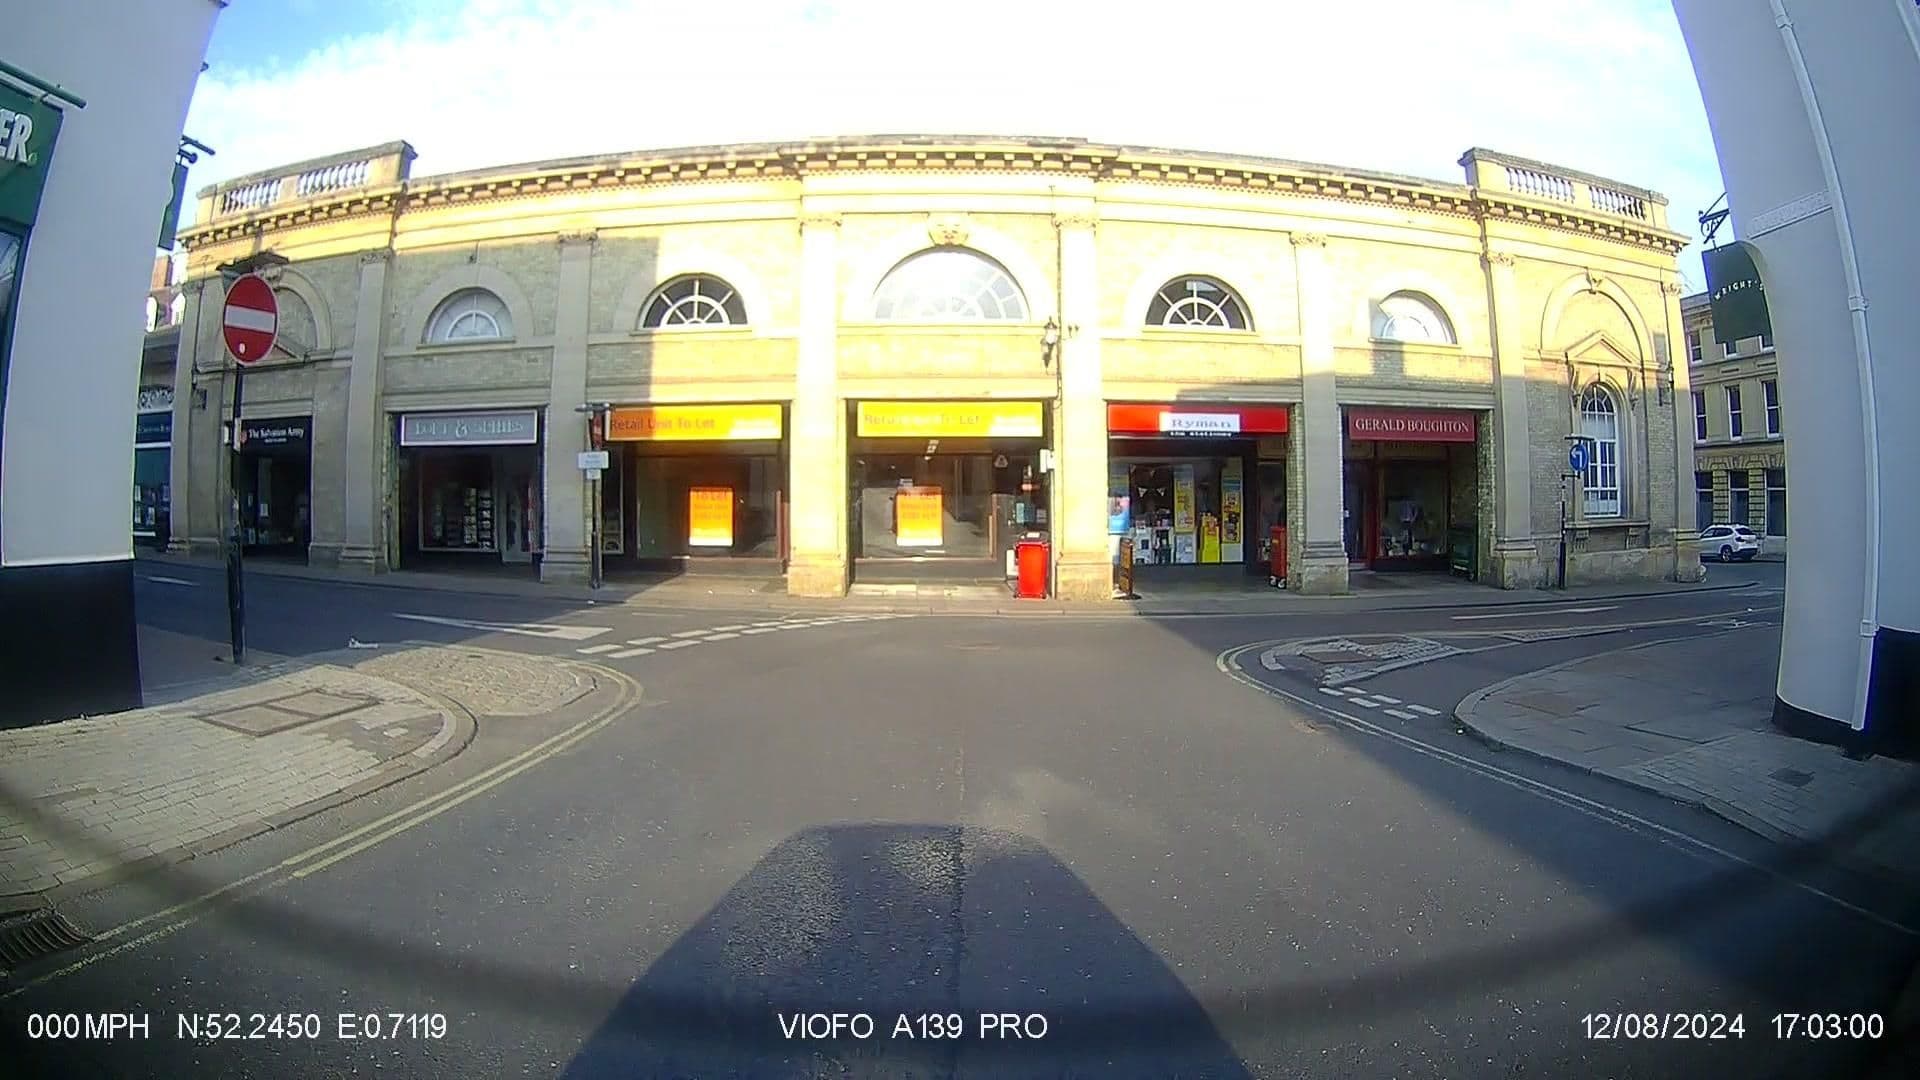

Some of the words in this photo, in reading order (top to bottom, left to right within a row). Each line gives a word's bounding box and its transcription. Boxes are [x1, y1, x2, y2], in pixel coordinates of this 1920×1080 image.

[455, 418, 468, 438] &
[611, 415, 643, 429] Retail
[678, 416, 692, 429] To
[695, 417, 716, 429] Let
[1172, 419, 1232, 431] Ryman
[1355, 418, 1405, 432] GERALD
[1407, 419, 1469, 433] BOUGHTON
[248, 429, 259, 439] The
